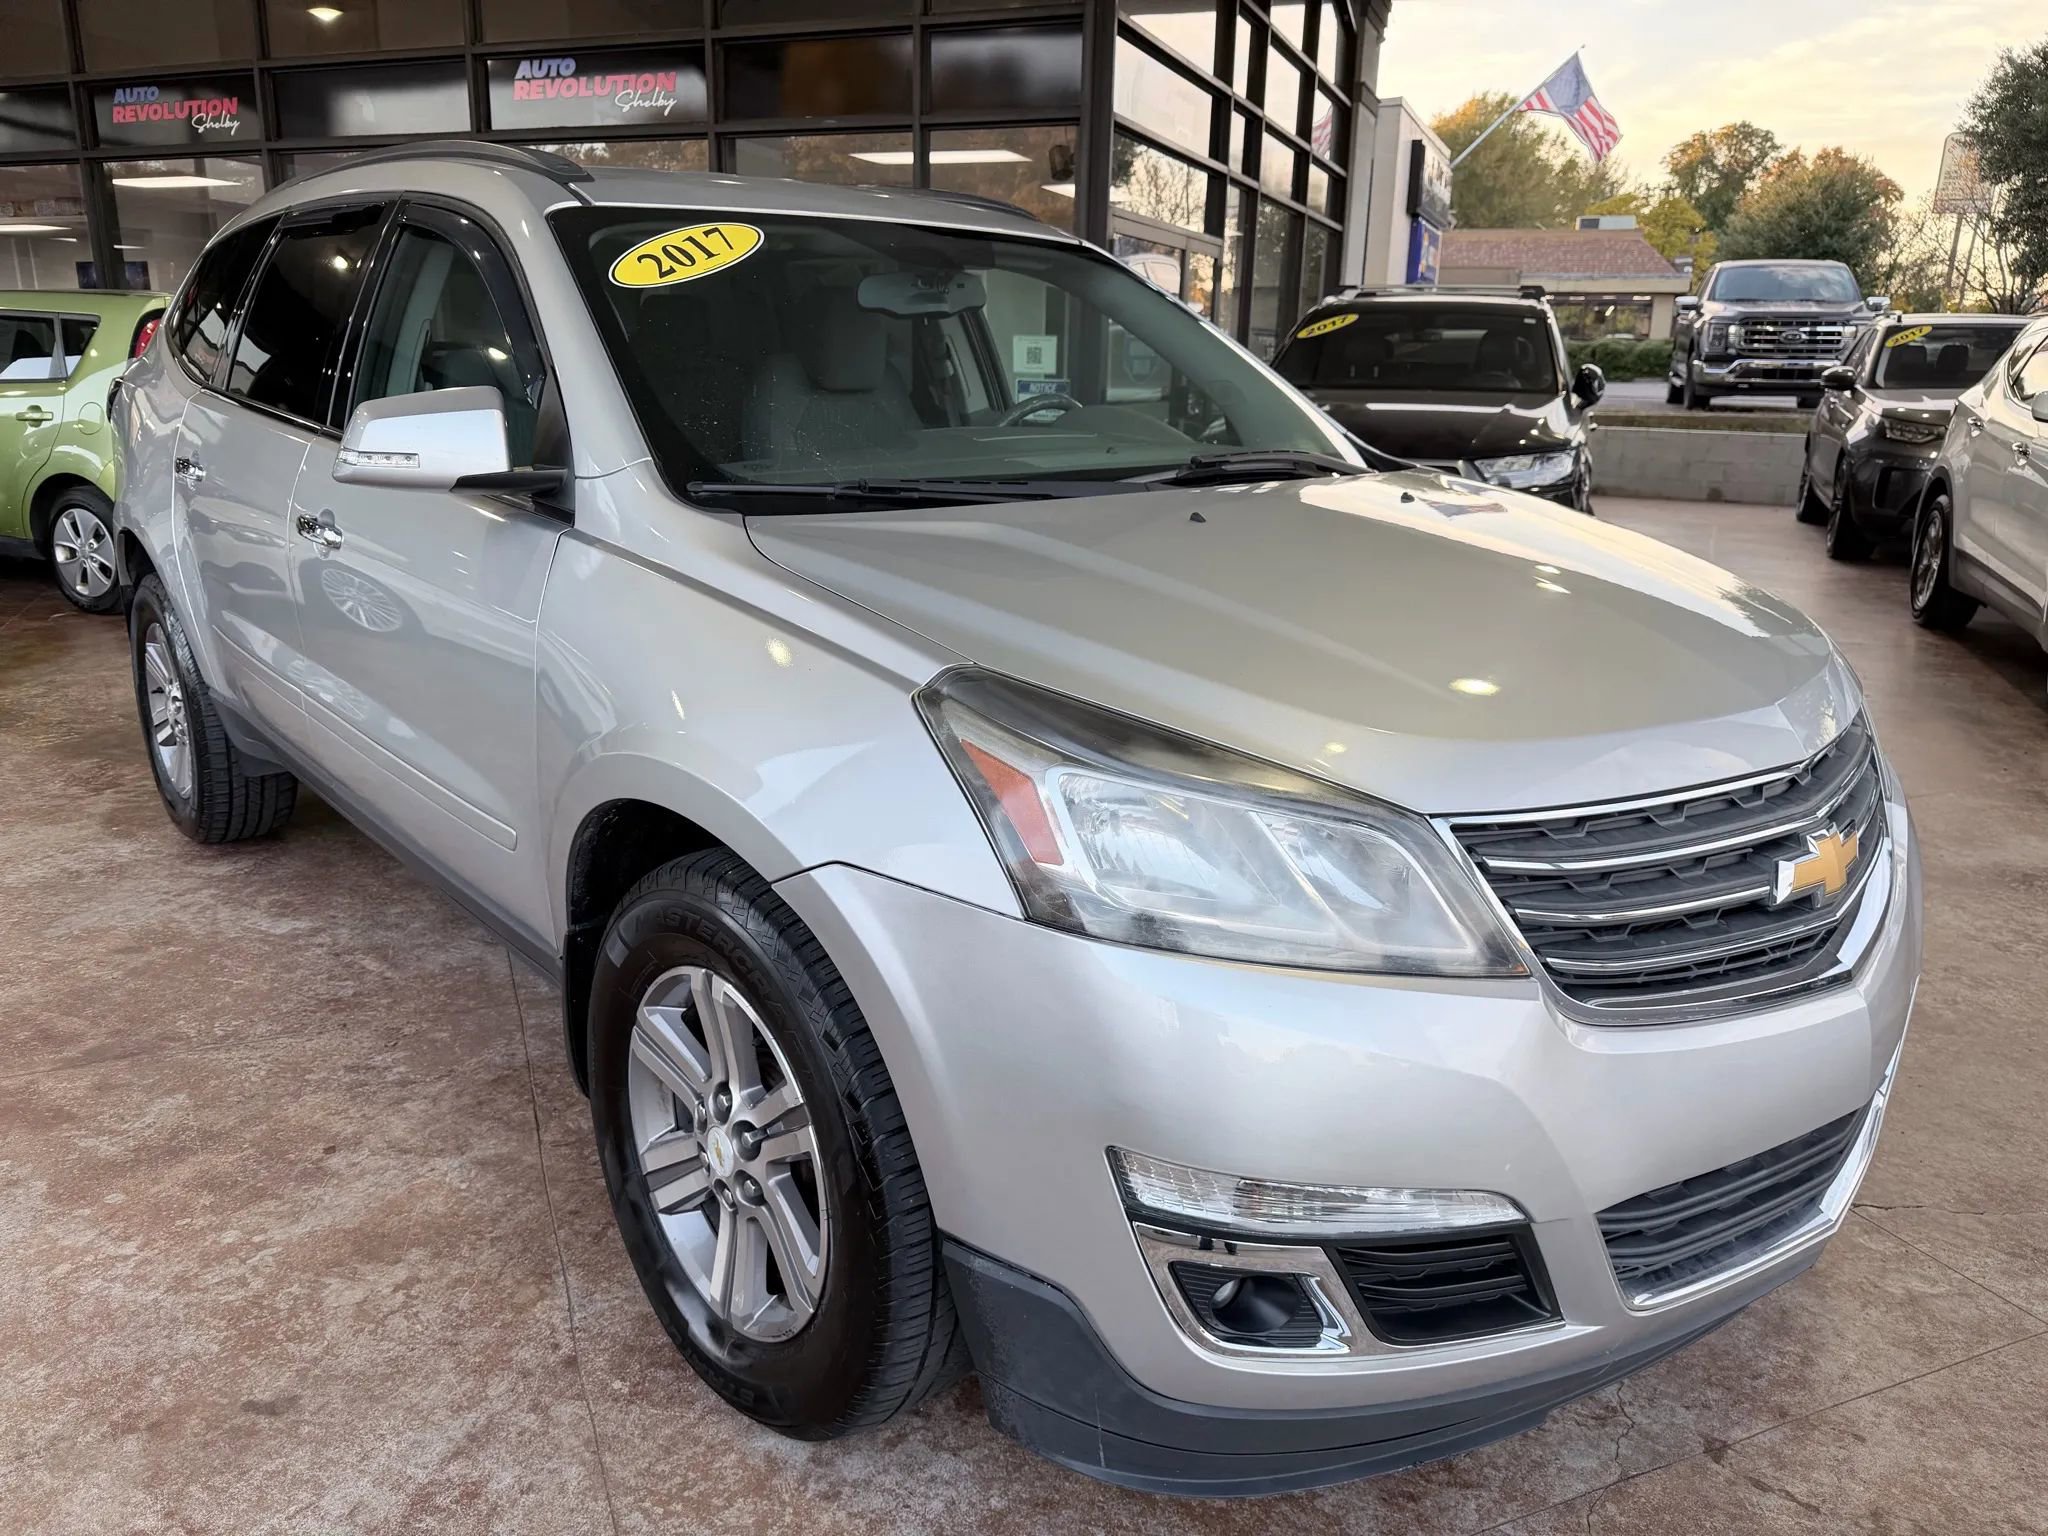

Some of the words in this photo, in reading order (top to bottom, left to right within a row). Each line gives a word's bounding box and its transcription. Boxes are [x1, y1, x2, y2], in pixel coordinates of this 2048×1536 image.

[514, 57, 577, 79] AUTO
[114, 86, 160, 104] AUTO
[512, 71, 678, 101] REVOLUTION
[112, 96, 239, 124] REVOLUTION
[614, 87, 678, 117] Shelby
[191, 111, 241, 136] Shelby
[636, 227, 734, 279] 2017
[1306, 316, 1348, 336] 2017
